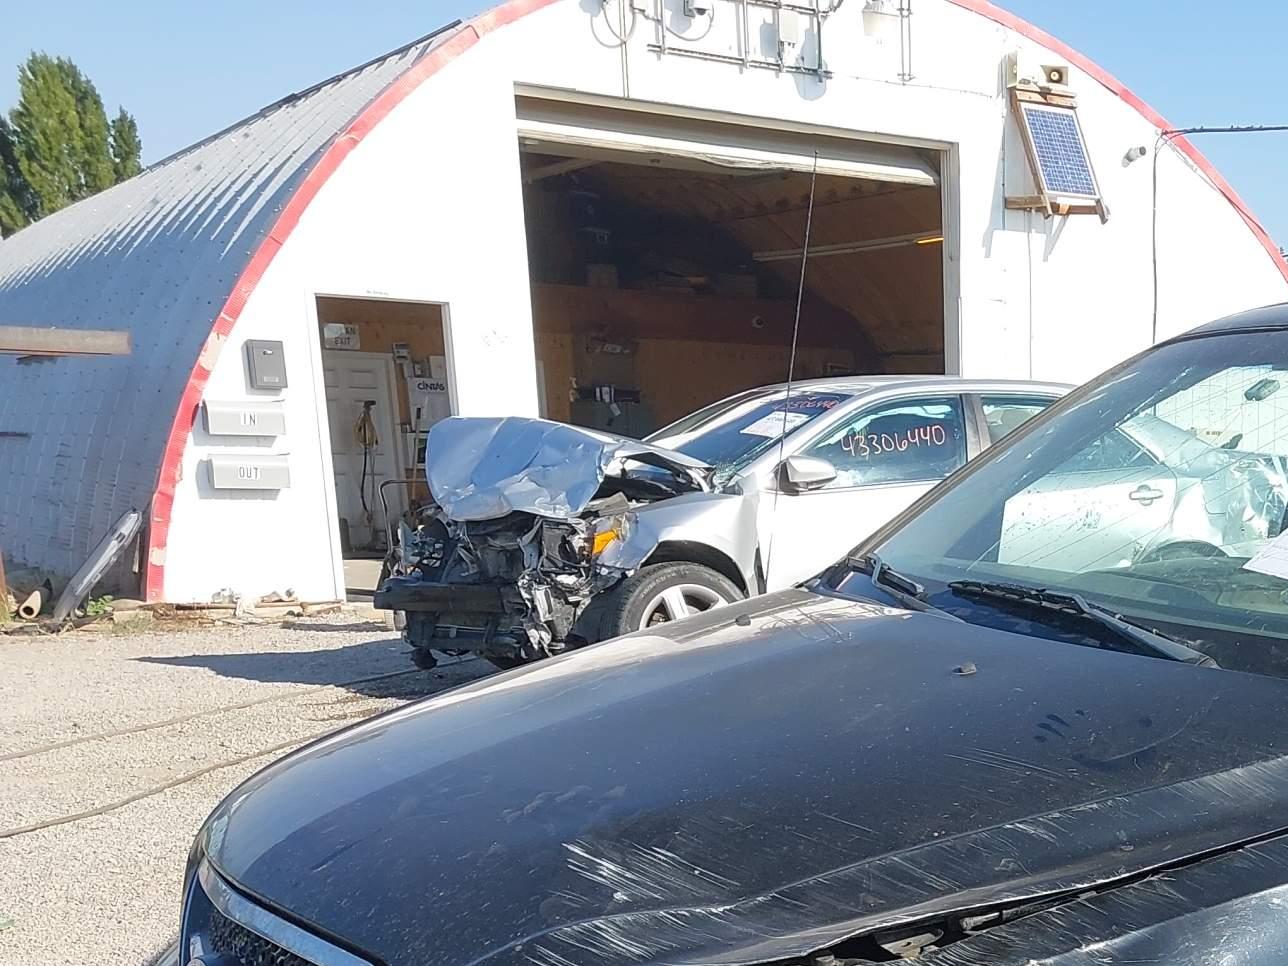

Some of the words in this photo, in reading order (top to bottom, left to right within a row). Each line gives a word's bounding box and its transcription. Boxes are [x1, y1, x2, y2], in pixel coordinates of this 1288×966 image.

[243, 413, 256, 426] IN
[840, 424, 946, 457] 43306440
[239, 466, 259, 479] OUT
